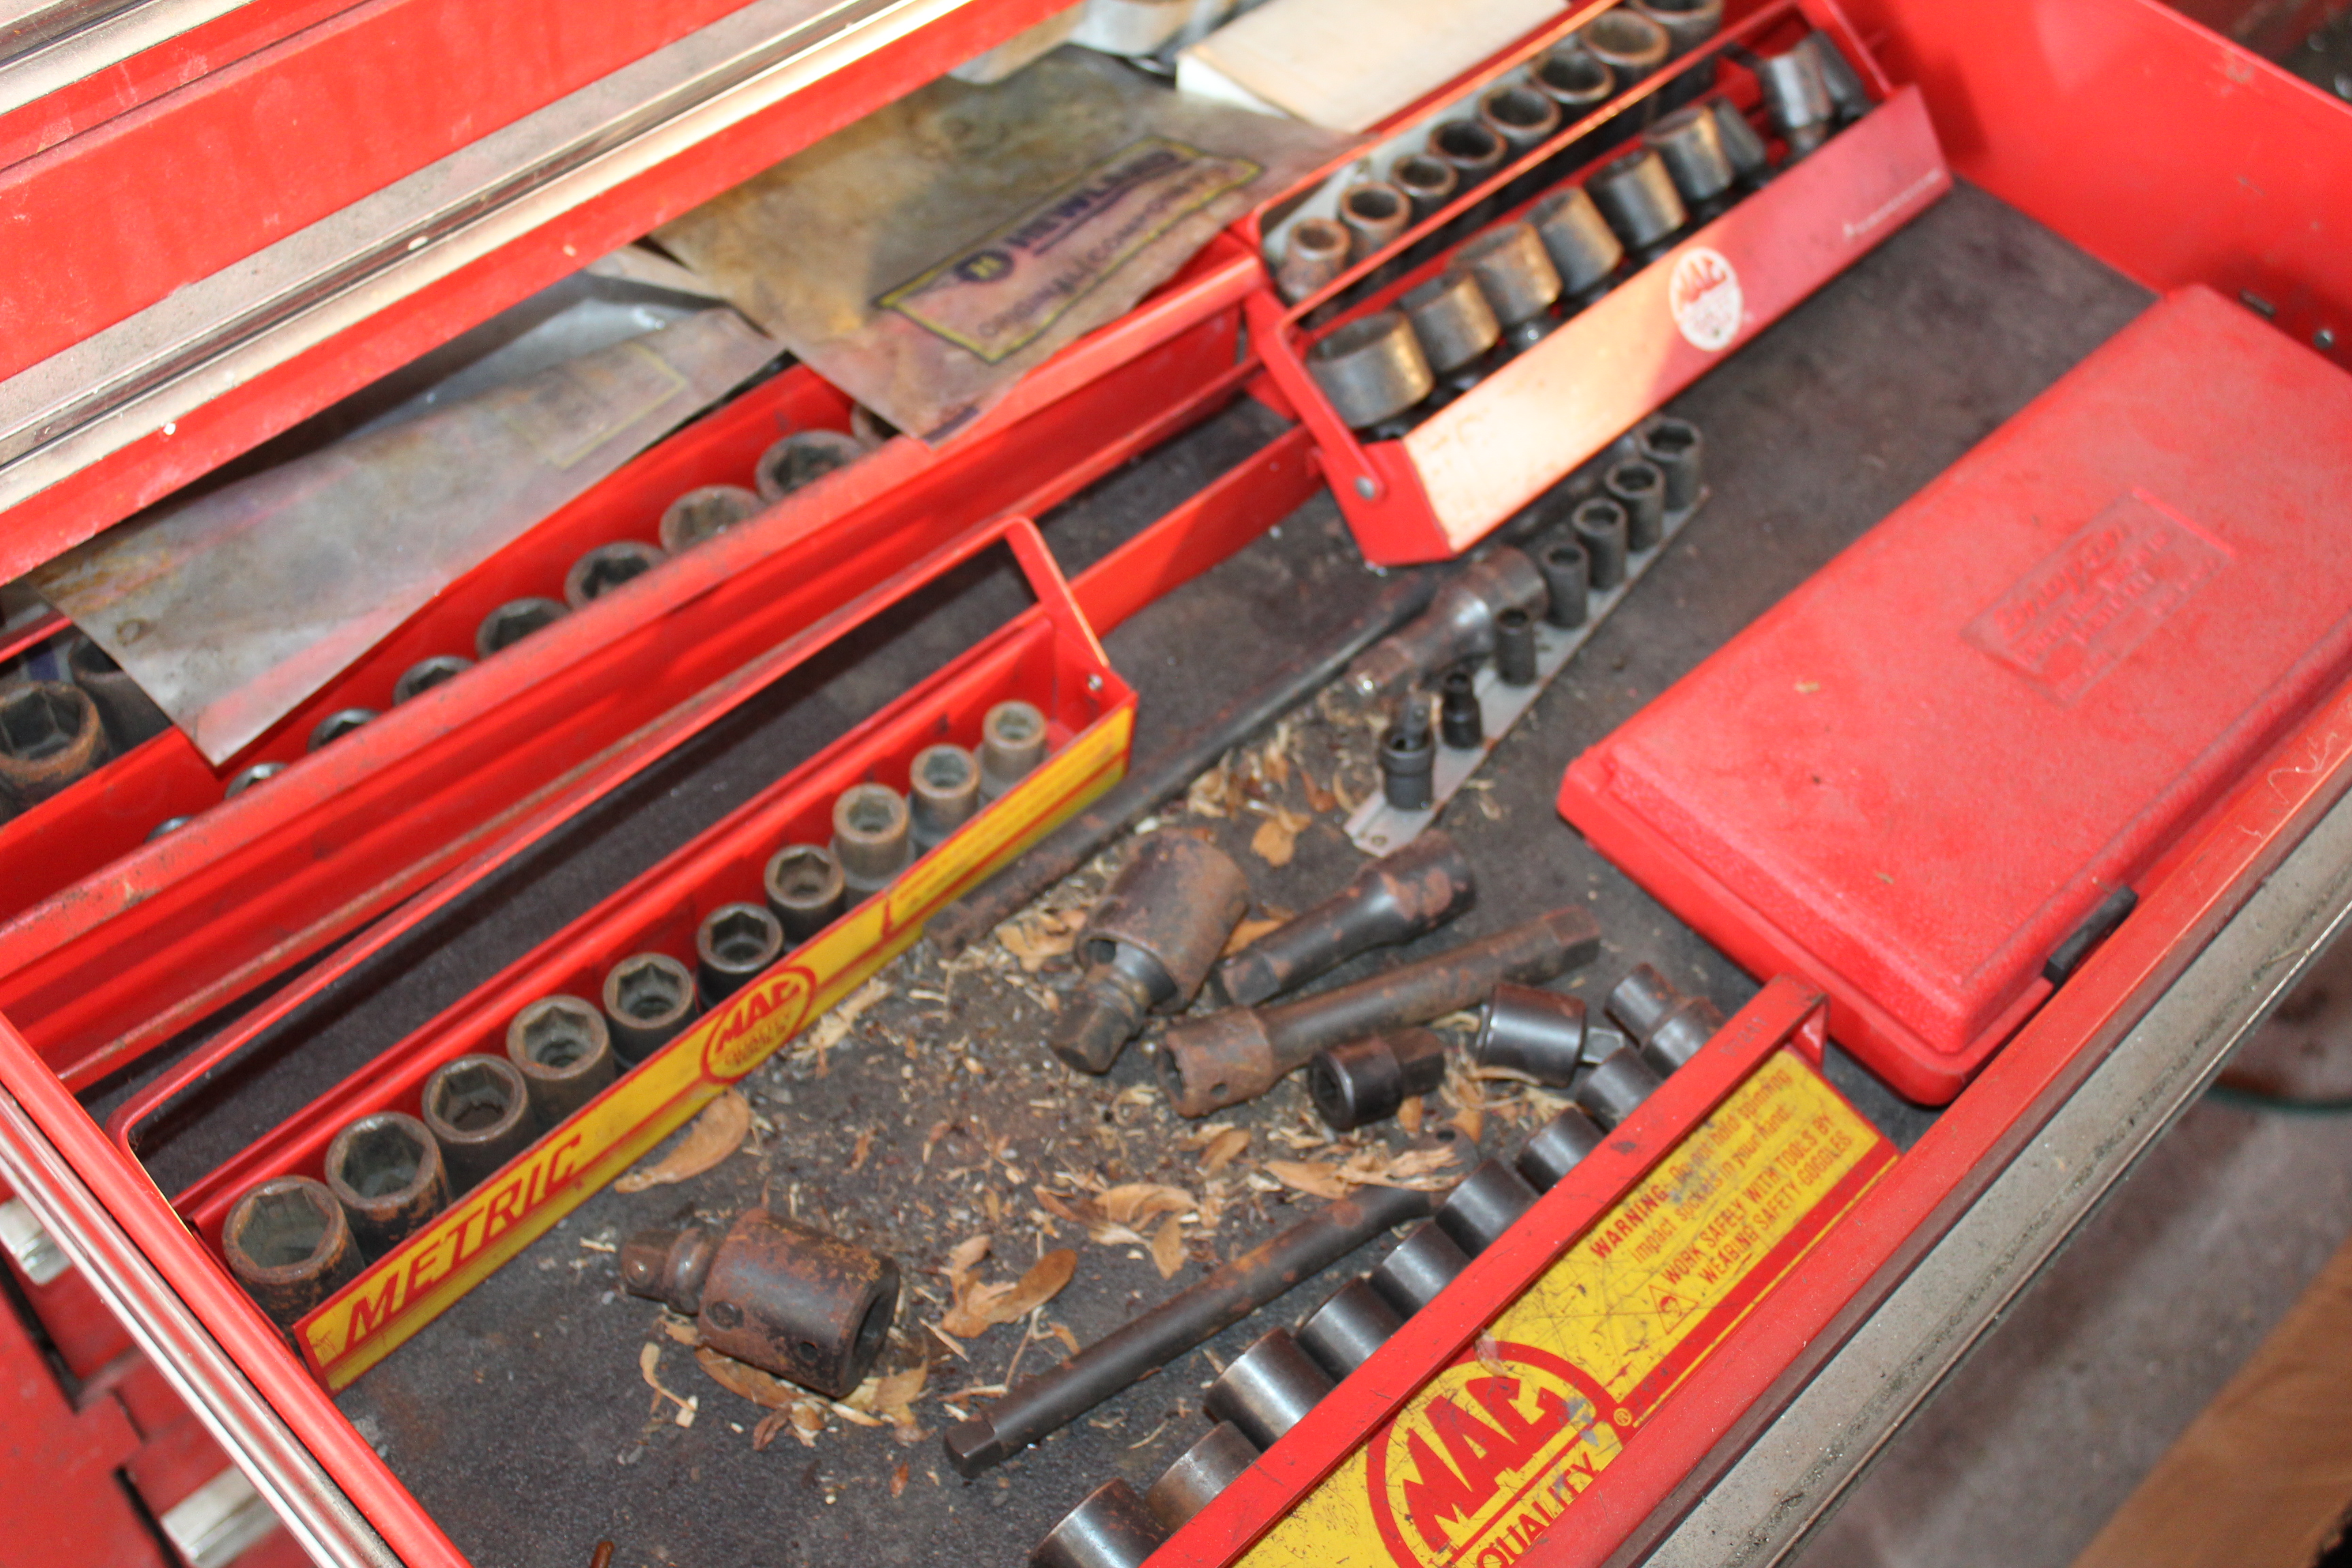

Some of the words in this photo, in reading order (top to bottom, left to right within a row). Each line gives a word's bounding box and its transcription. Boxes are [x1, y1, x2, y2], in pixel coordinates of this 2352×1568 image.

[716, 981, 800, 1054] MAC
[1709, 1112, 1741, 1147] hold
[342, 1133, 582, 1353] METRIC
[1631, 1215, 1678, 1264] impact
[1717, 1160, 1735, 1181] in
[1731, 1134, 1761, 1169] your
[1661, 1242, 1707, 1286] WORK
[1701, 1199, 1748, 1249] SAFELY
[1742, 1164, 1782, 1204] WITH
[1776, 1129, 1818, 1173] TOOLS
[1812, 1113, 1835, 1136] BY
[1698, 1226, 1760, 1285] WEARING
[1752, 1179, 1802, 1232] SAFETY
[1403, 1375, 1573, 1554] MAC
[1476, 1451, 1601, 1568] QUALITY
